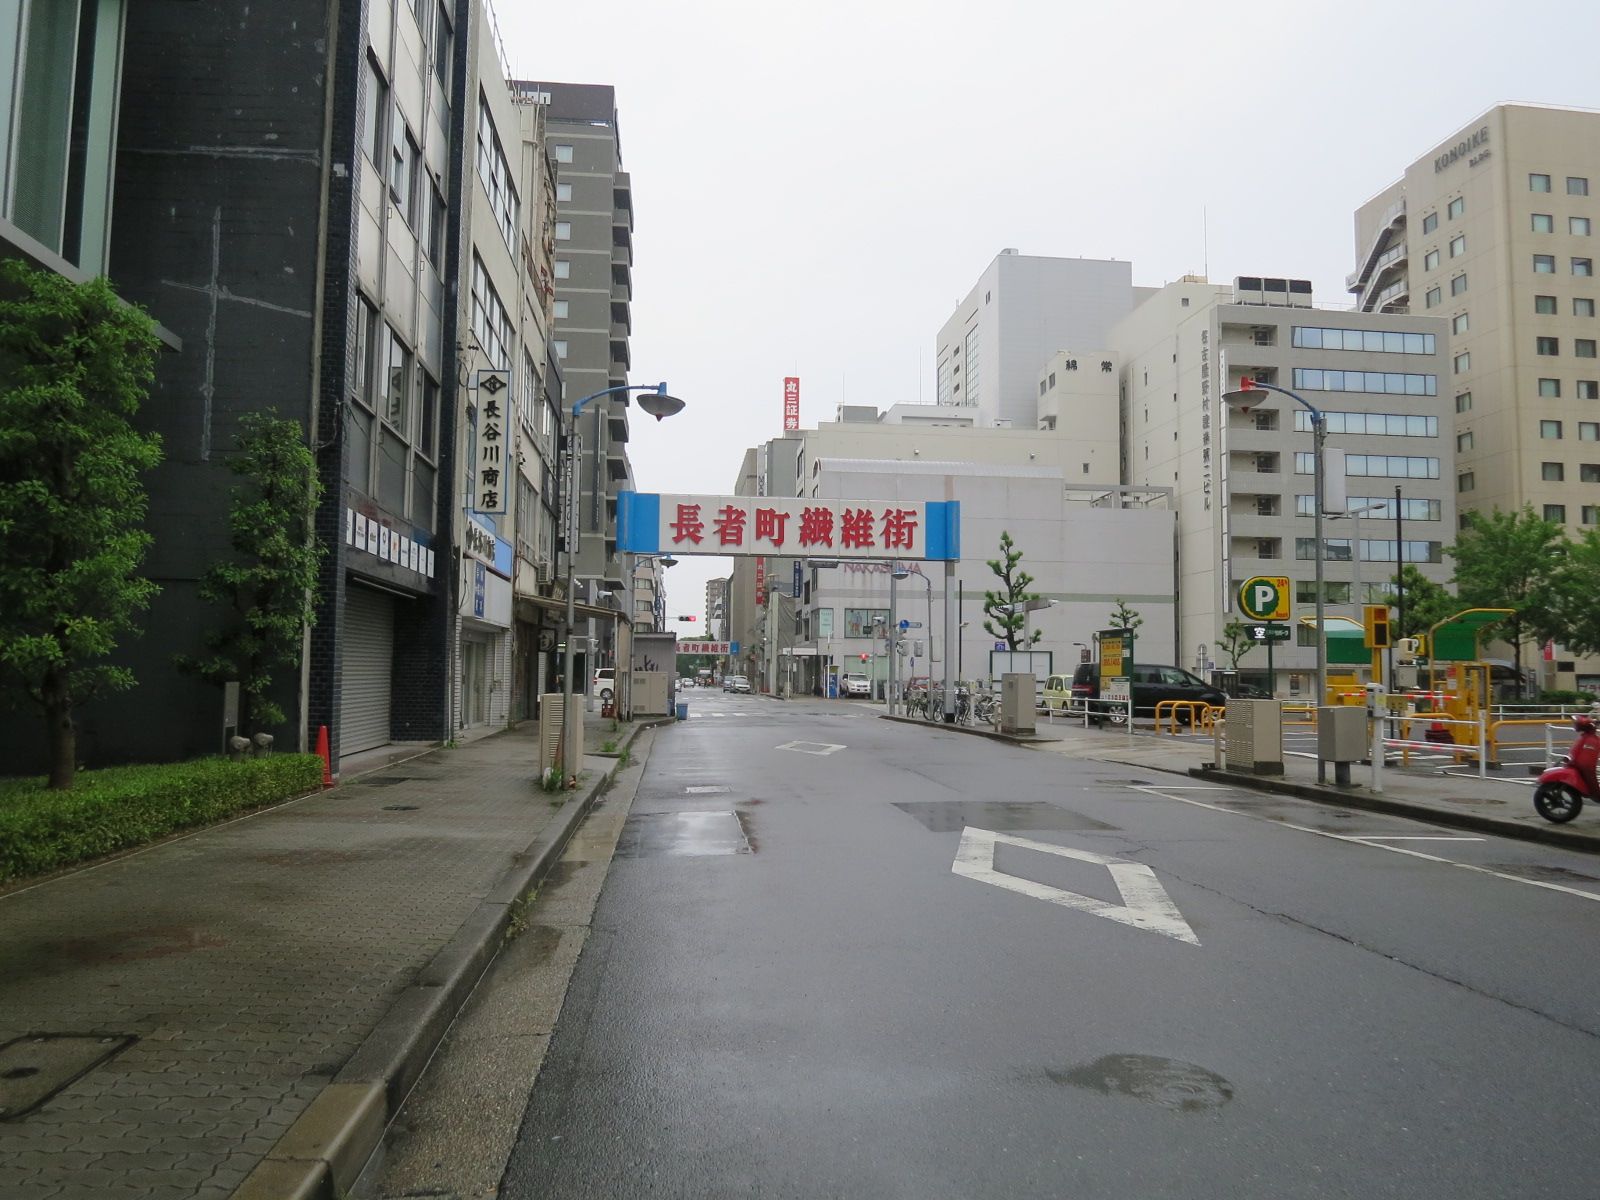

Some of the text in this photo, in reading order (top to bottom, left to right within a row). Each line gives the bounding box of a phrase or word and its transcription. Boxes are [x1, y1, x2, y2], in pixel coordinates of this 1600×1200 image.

[1434, 126, 1489, 174] KONOIKE
[785, 381, 798, 429] 丸三証券
[480, 400, 502, 509] 長谷川商店
[669, 502, 919, 550] 長者町繊維街
[1254, 585, 1275, 612] P
[1253, 626, 1266, 639] 空
